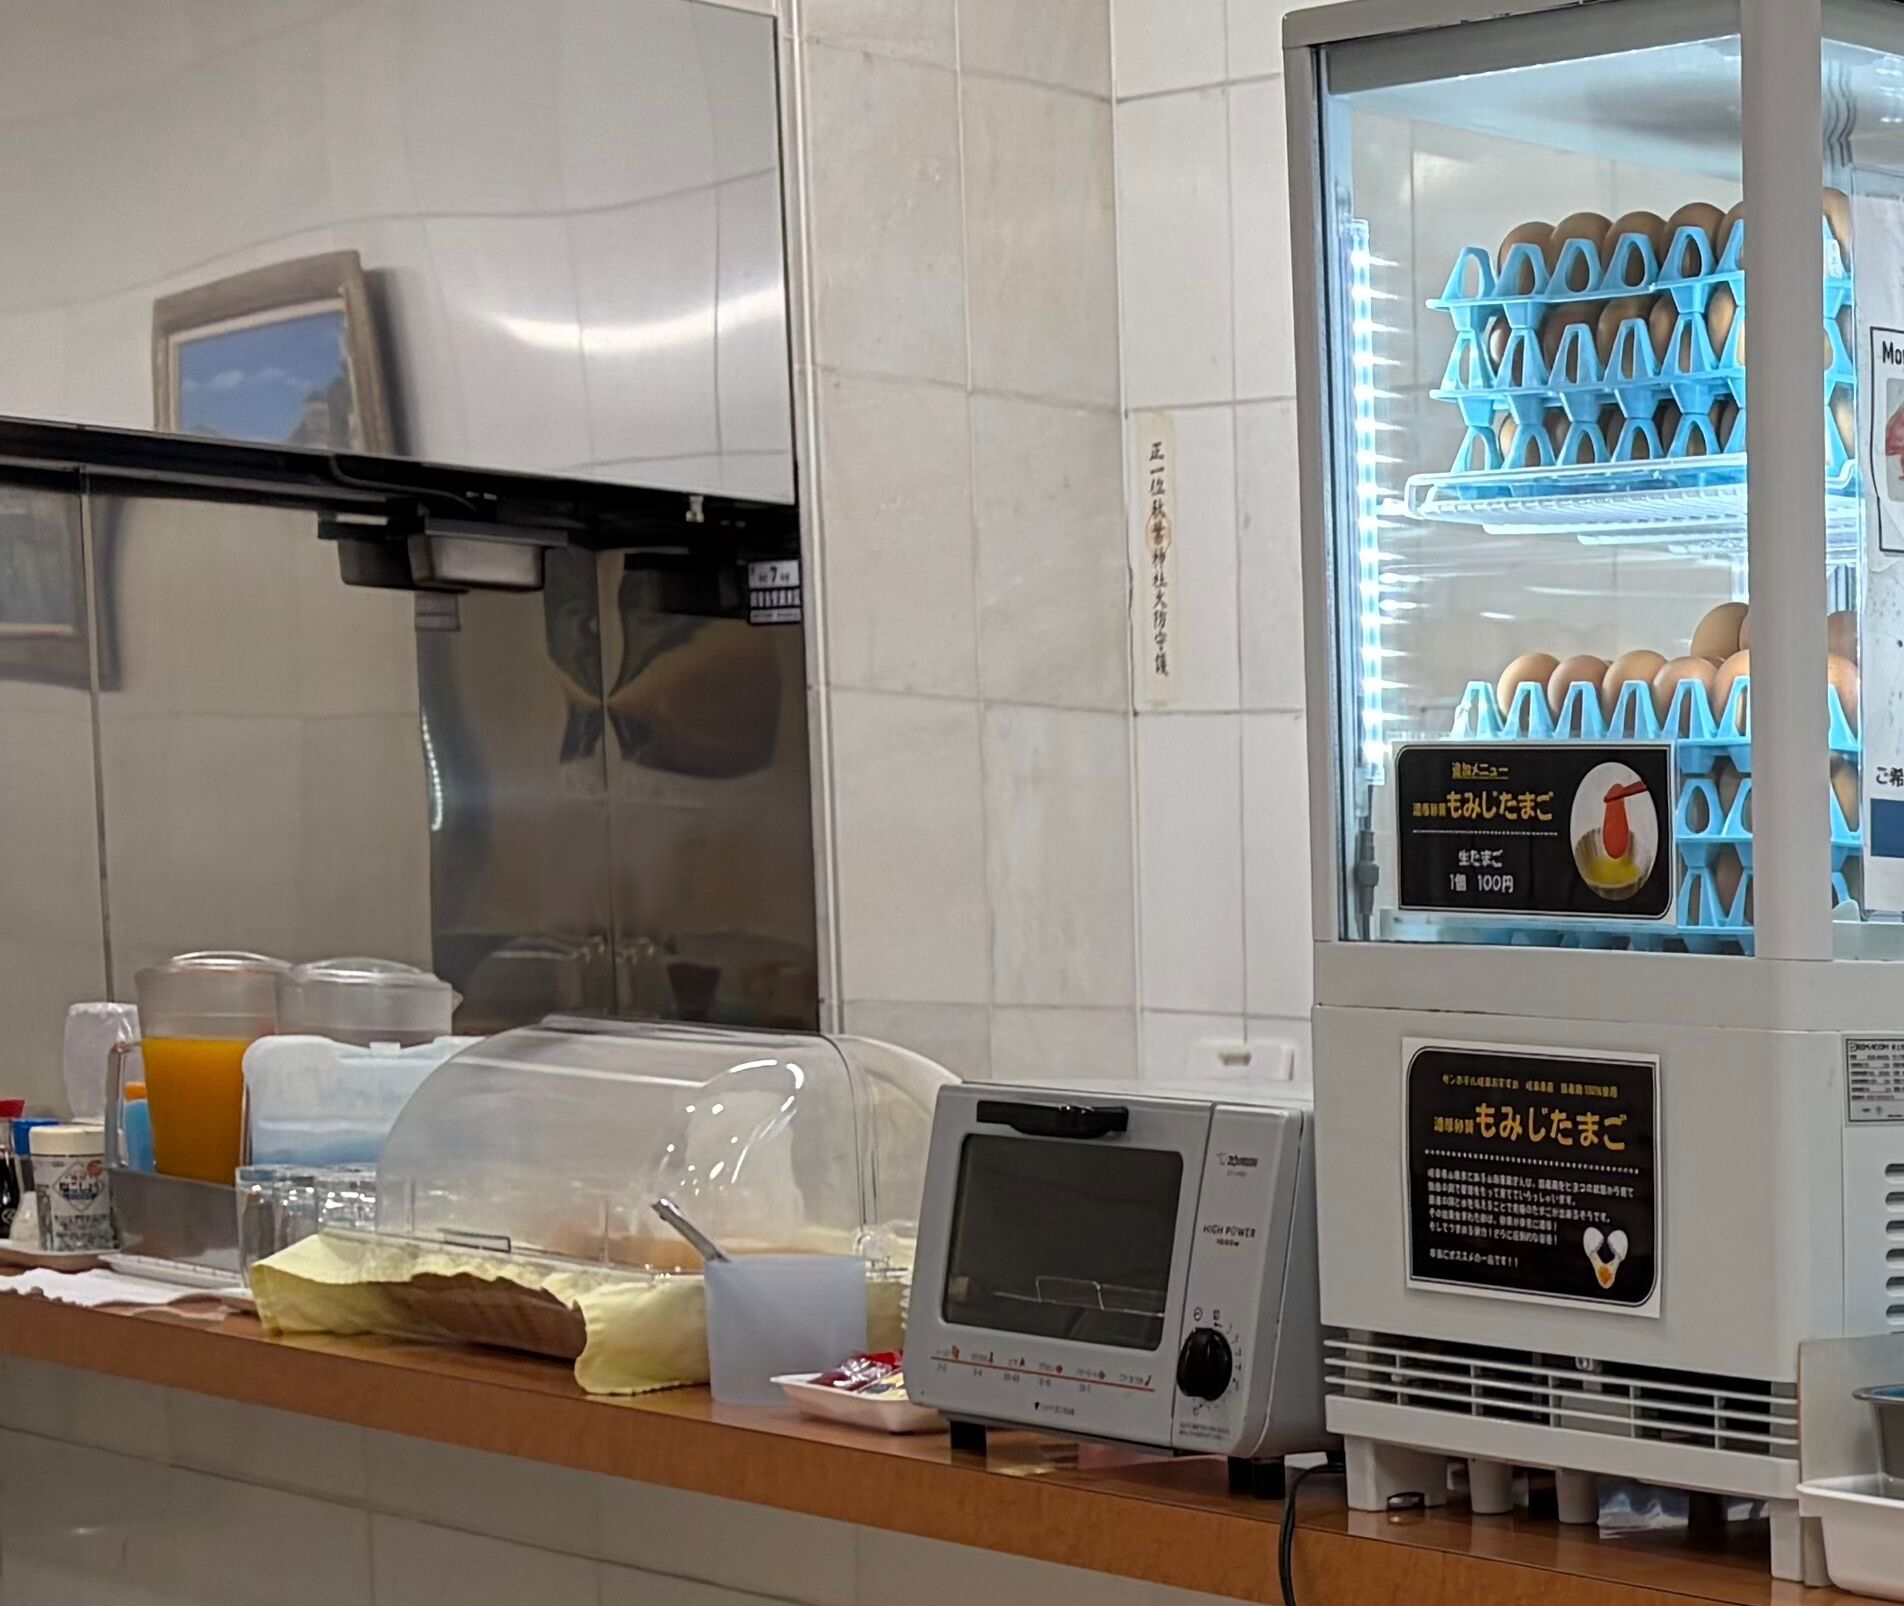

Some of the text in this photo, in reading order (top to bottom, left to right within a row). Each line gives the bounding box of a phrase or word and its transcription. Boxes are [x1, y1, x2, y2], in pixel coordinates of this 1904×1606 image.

[1446, 789, 1555, 821] もみじたまご
[1458, 848, 1503, 868] 生たまご
[1450, 873, 1514, 894] 1個 100円
[1475, 1102, 1628, 1150] もみじたまご
[1203, 1224, 1256, 1239] HIGH POWER
